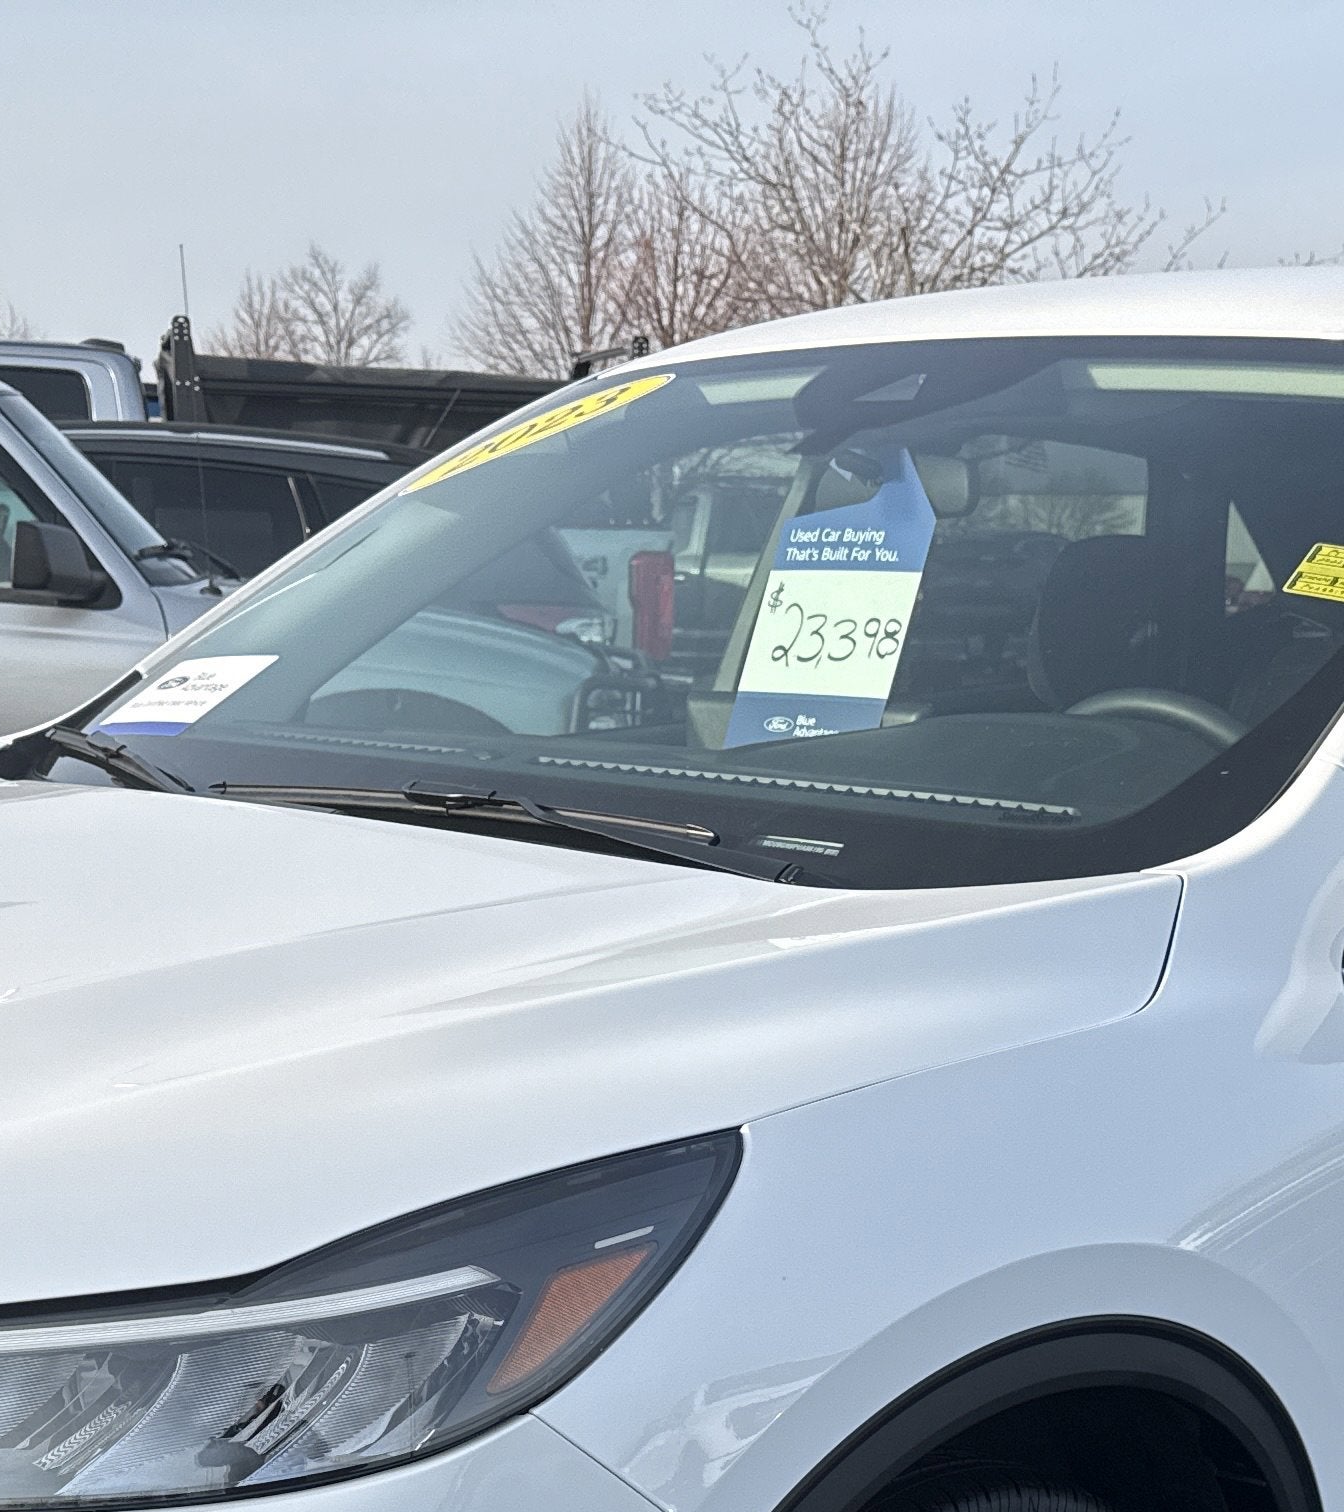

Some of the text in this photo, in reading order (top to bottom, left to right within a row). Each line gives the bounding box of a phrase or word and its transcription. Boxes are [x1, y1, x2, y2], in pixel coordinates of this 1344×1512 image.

[437, 386, 631, 479] 2023
[790, 527, 886, 546] Used Car Buying
[786, 547, 900, 562] That's Built For You.
[771, 602, 903, 670] 23,398
[766, 715, 817, 731] Ford Blue
